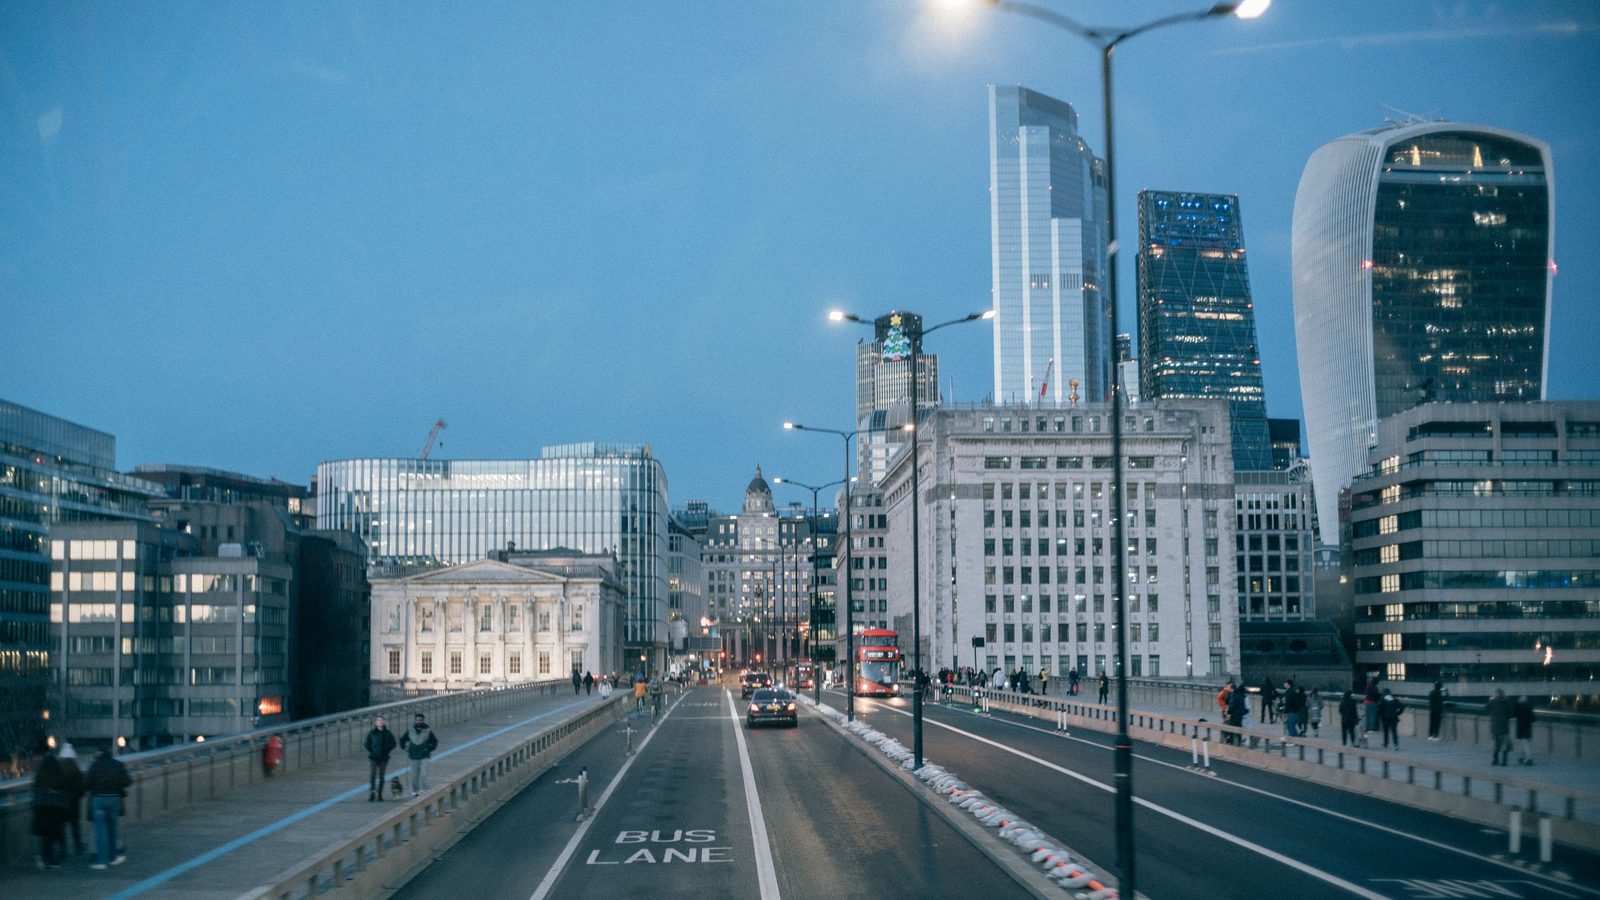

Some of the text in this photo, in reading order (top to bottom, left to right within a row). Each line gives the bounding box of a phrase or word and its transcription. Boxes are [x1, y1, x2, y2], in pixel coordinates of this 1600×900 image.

[615, 829, 716, 844] BUS
[585, 846, 735, 865] LANE
[1367, 878, 1581, 899] LANE
